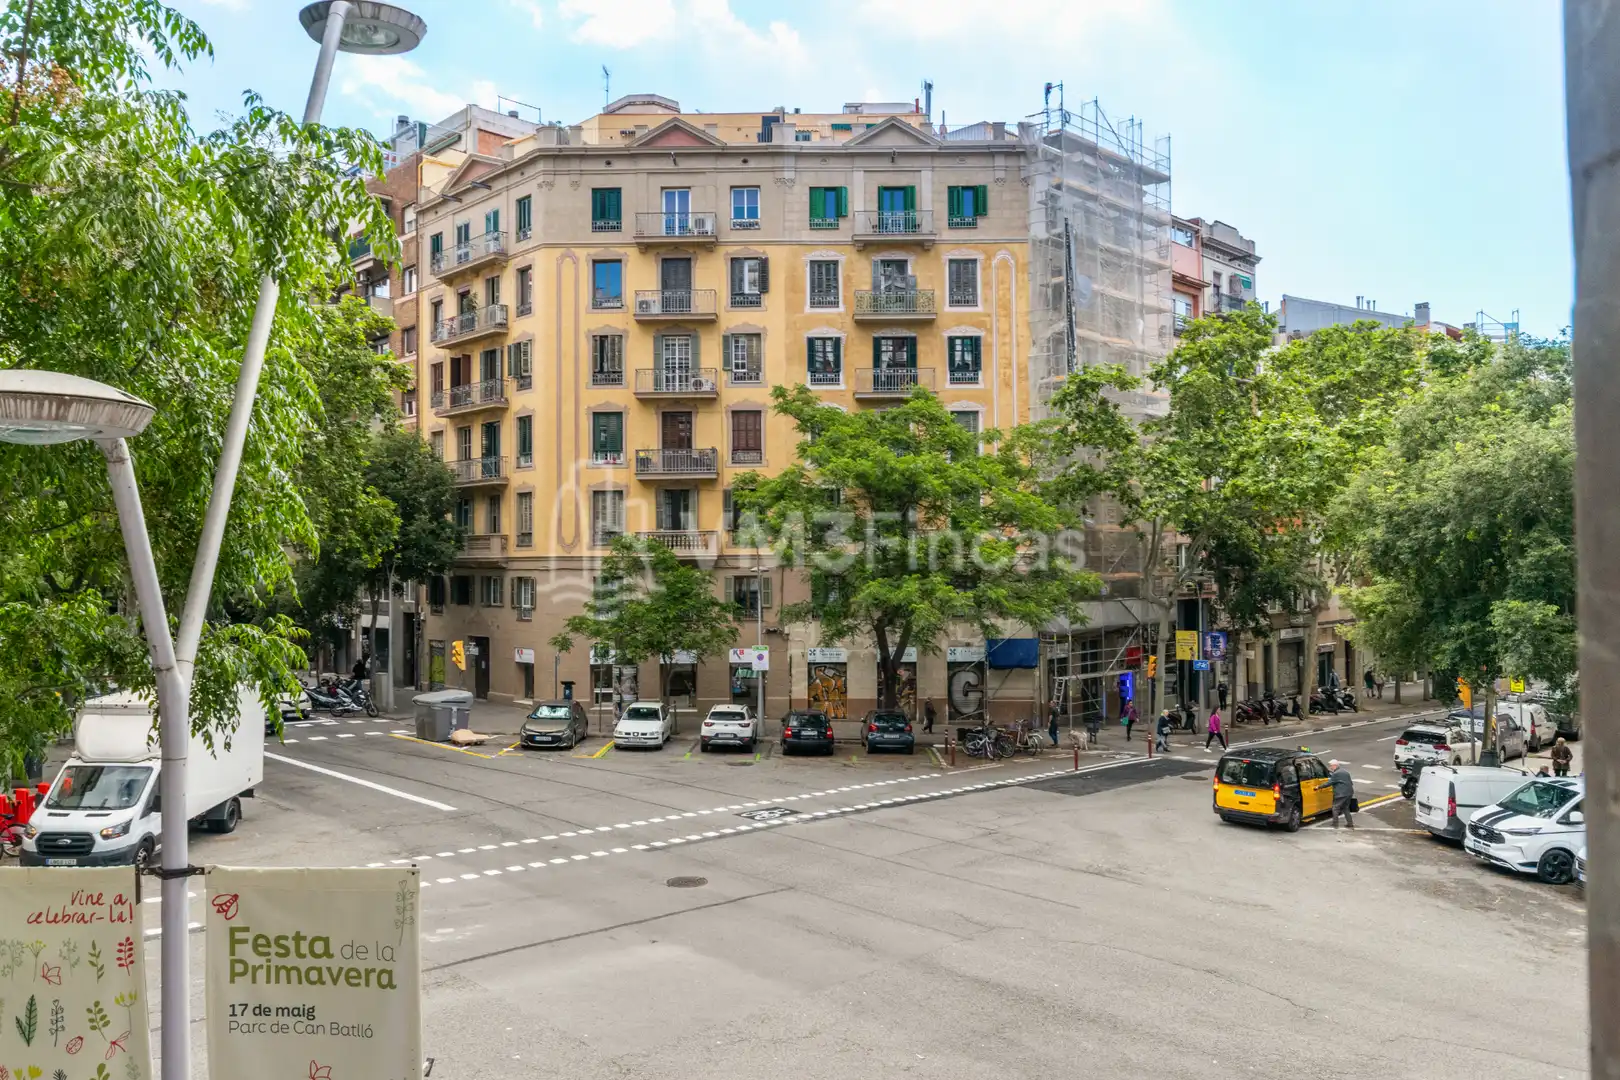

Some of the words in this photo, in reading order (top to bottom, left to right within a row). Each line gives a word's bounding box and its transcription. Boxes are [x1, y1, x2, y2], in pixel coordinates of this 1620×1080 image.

[113, 893, 129, 906] a
[229, 926, 334, 959] Festa
[340, 940, 369, 960] de
[376, 941, 397, 962] la
[229, 958, 397, 990] Primavera
[229, 1003, 249, 1017] 17
[252, 1003, 272, 1017] de
[275, 1003, 316, 1021] maig
[228, 1020, 266, 1034] Parc
[270, 1020, 290, 1034] de
[293, 1020, 326, 1035] Can
[330, 1021, 374, 1039] Batlló
